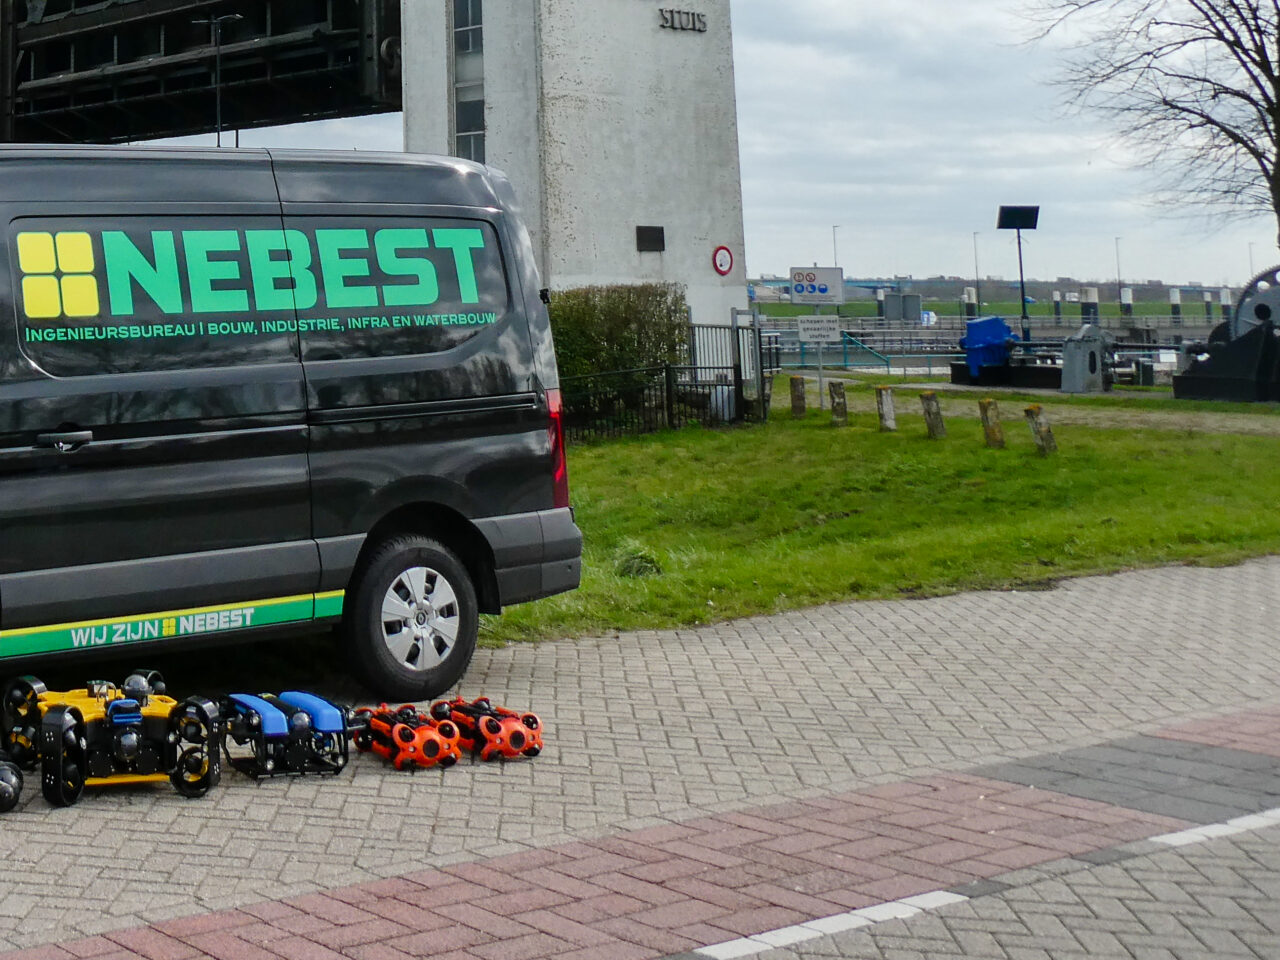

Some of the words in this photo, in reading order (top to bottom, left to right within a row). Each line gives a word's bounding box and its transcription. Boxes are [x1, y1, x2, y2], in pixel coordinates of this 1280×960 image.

[658, 8, 707, 33] SLUIS
[100, 228, 485, 316] NEBEST
[25, 321, 195, 342] INGENIEURSBUREAU
[207, 320, 258, 335] BOUW,
[261, 317, 345, 333] INDUSTRIE,
[348, 315, 390, 329] INFRA
[392, 315, 412, 328] EN
[413, 312, 497, 327] WATERBOUW
[70, 626, 107, 647] WIJ
[112, 620, 159, 643] ZIJN
[179, 607, 255, 635] NEBEST
